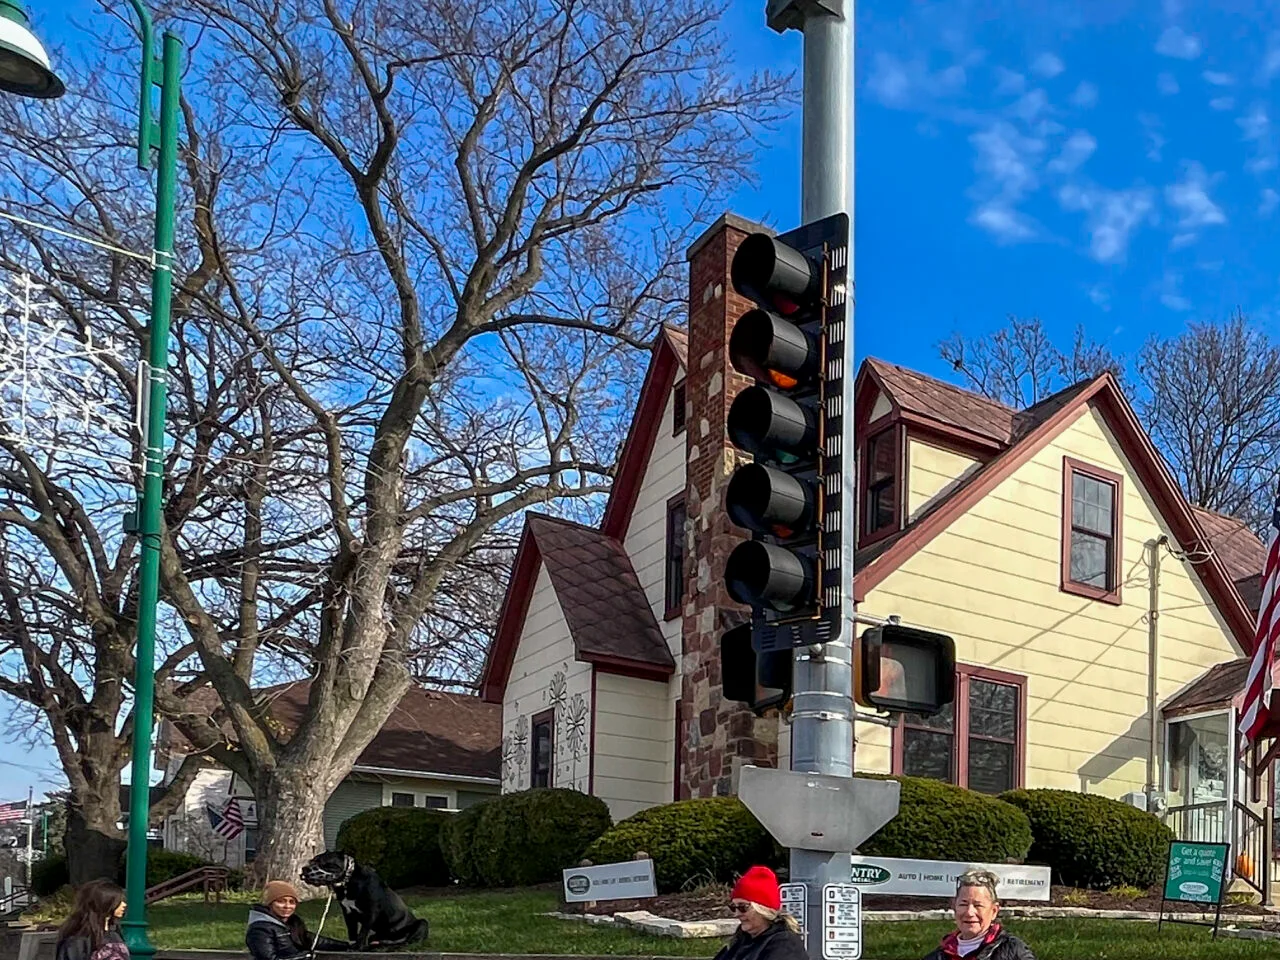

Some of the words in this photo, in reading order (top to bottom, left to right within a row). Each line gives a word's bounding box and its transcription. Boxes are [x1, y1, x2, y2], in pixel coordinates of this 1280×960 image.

[1181, 847, 1191, 856] Get
[1198, 850, 1216, 858] quote
[1183, 857, 1195, 865] and
[851, 867, 882, 879] NTRY
